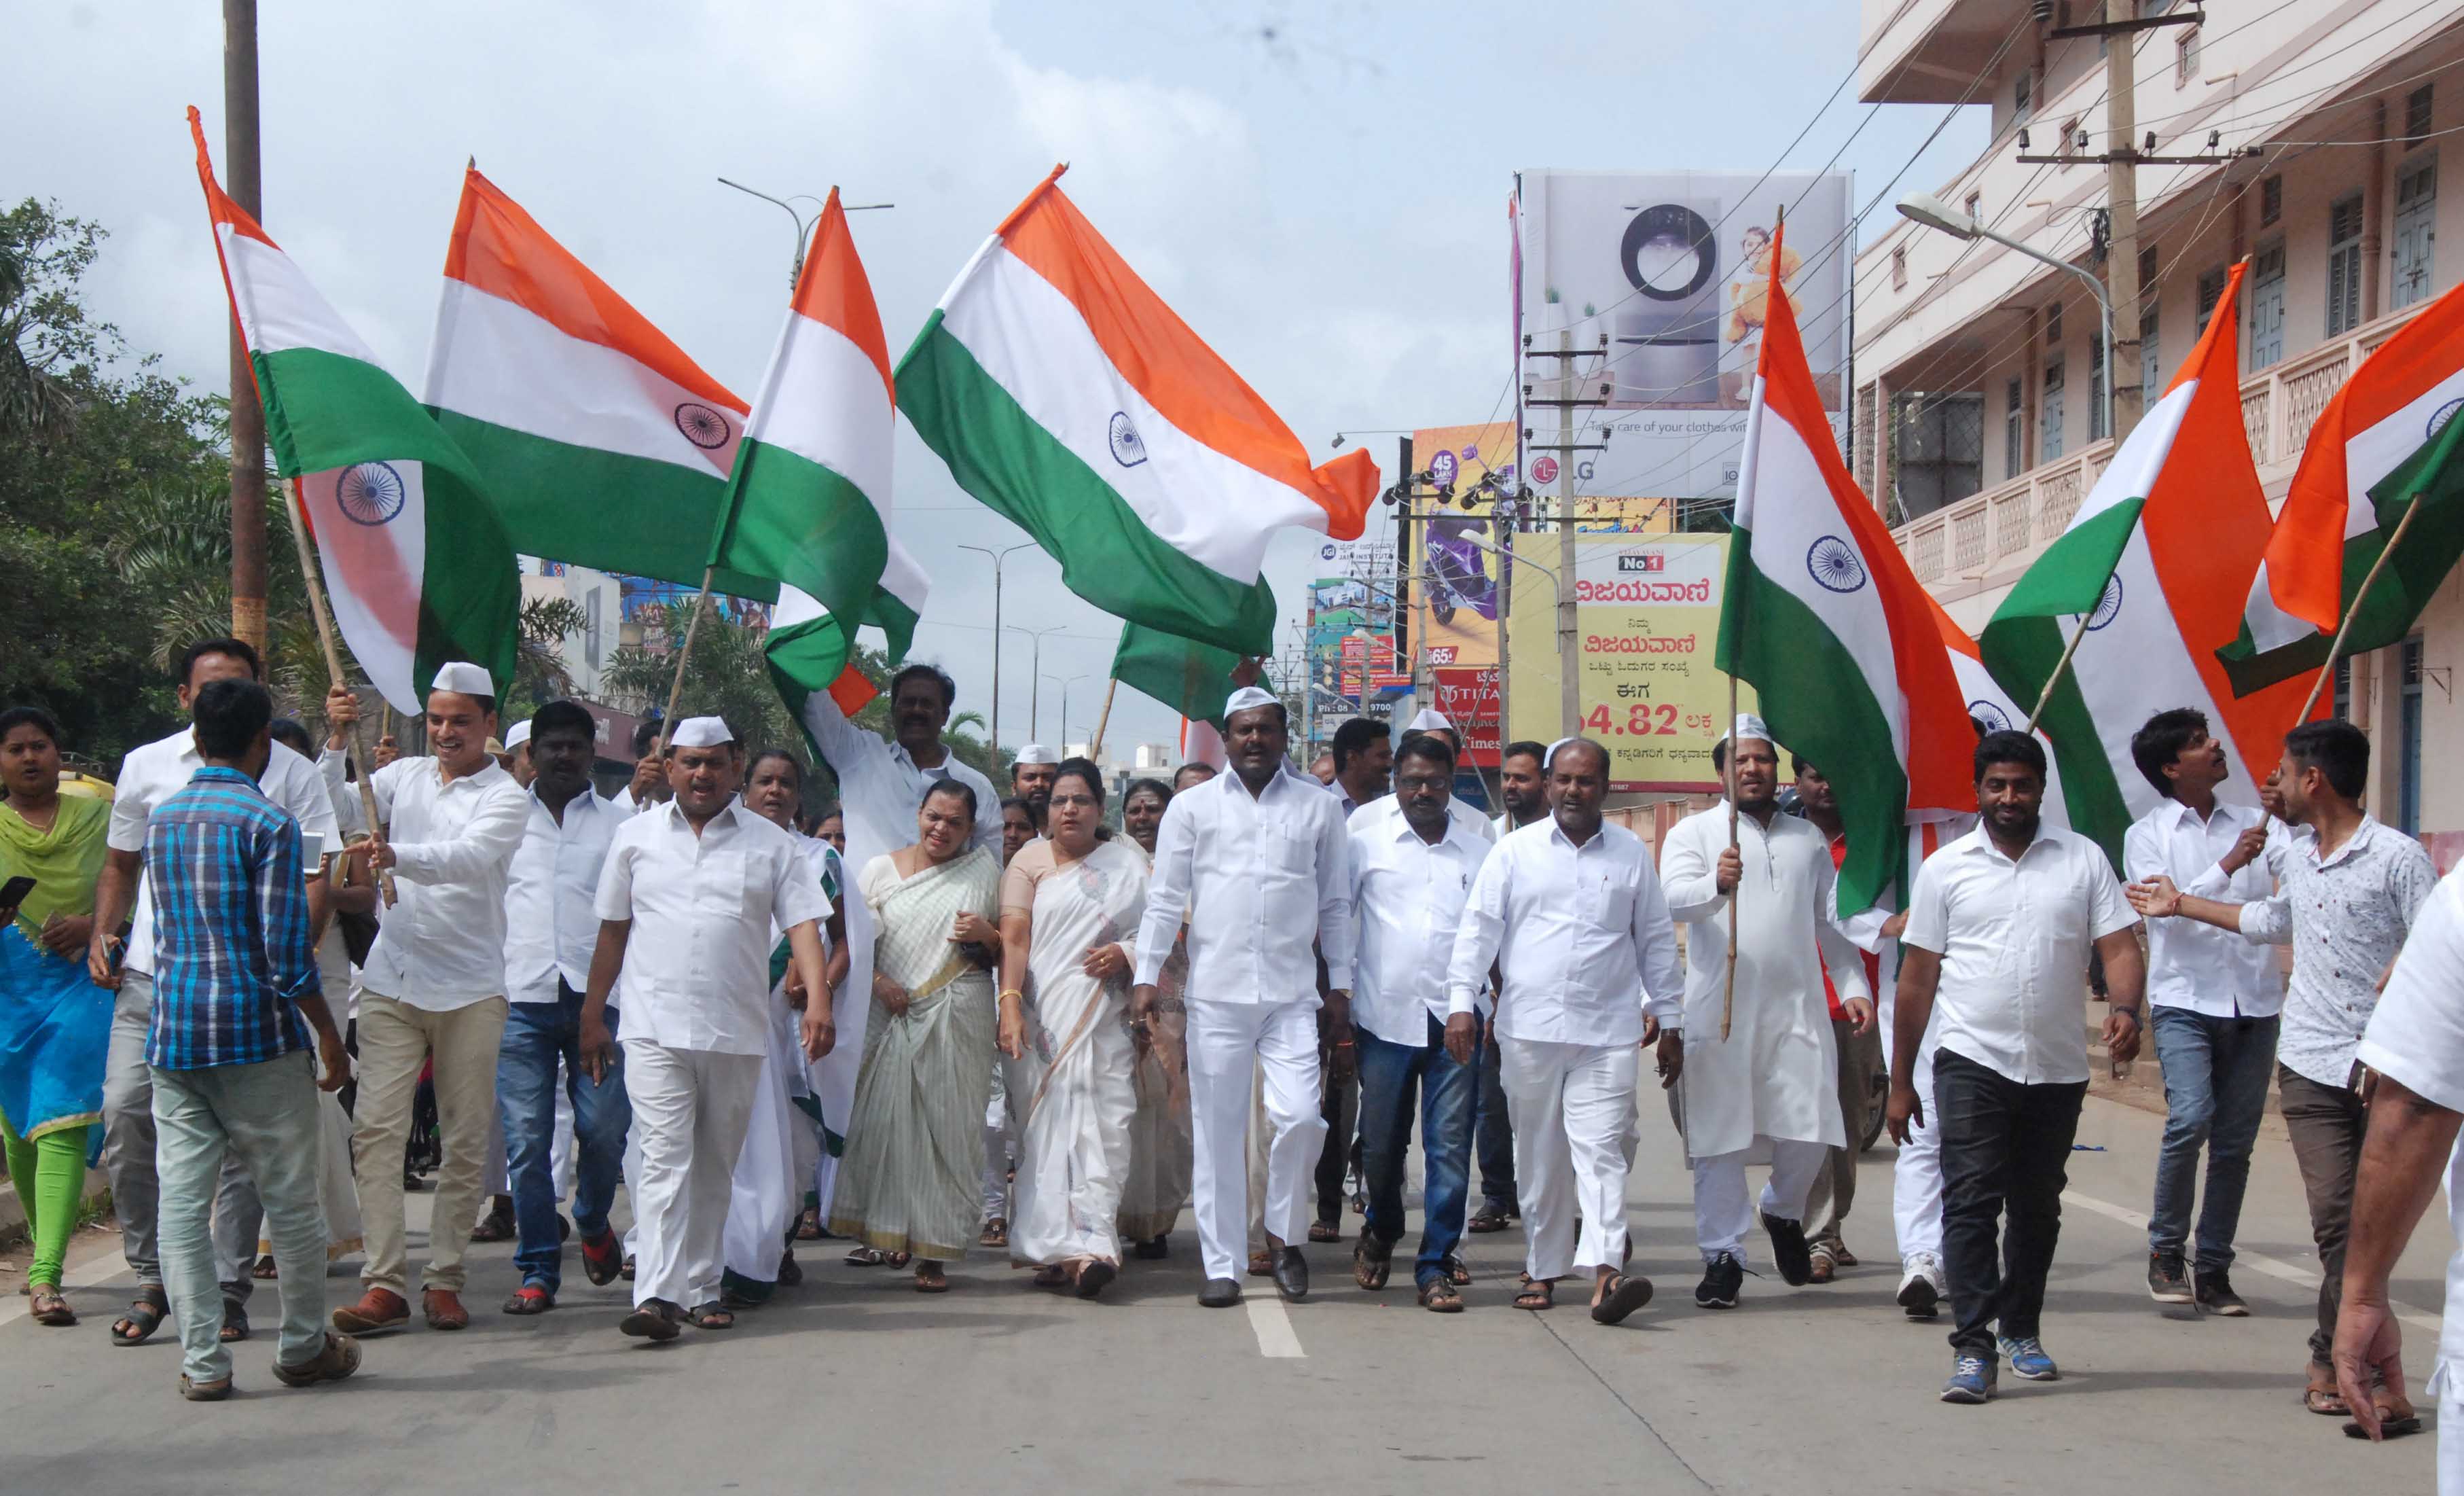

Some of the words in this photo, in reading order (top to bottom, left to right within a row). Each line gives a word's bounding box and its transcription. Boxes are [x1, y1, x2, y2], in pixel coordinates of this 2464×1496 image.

[1618, 423, 1641, 431] care
[1644, 420, 1656, 431] of
[1658, 423, 1683, 434] your
[1686, 421, 1726, 432] clothes
[1728, 422, 1747, 432] wit
[1434, 455, 1452, 469] 45
[1574, 461, 1594, 480] G
[1625, 557, 1645, 569] No
[1650, 557, 1658, 569] 1
[1576, 577, 1710, 602] ವಿಜಯವಾಣಿ
[1584, 634, 1696, 653] ವಿಜಯವಾಣಿ
[1459, 688, 1500, 700] TITA
[1617, 682, 1650, 698] ಈಗ
[1669, 749, 1714, 763] ಧನ್ಯವಾದ
